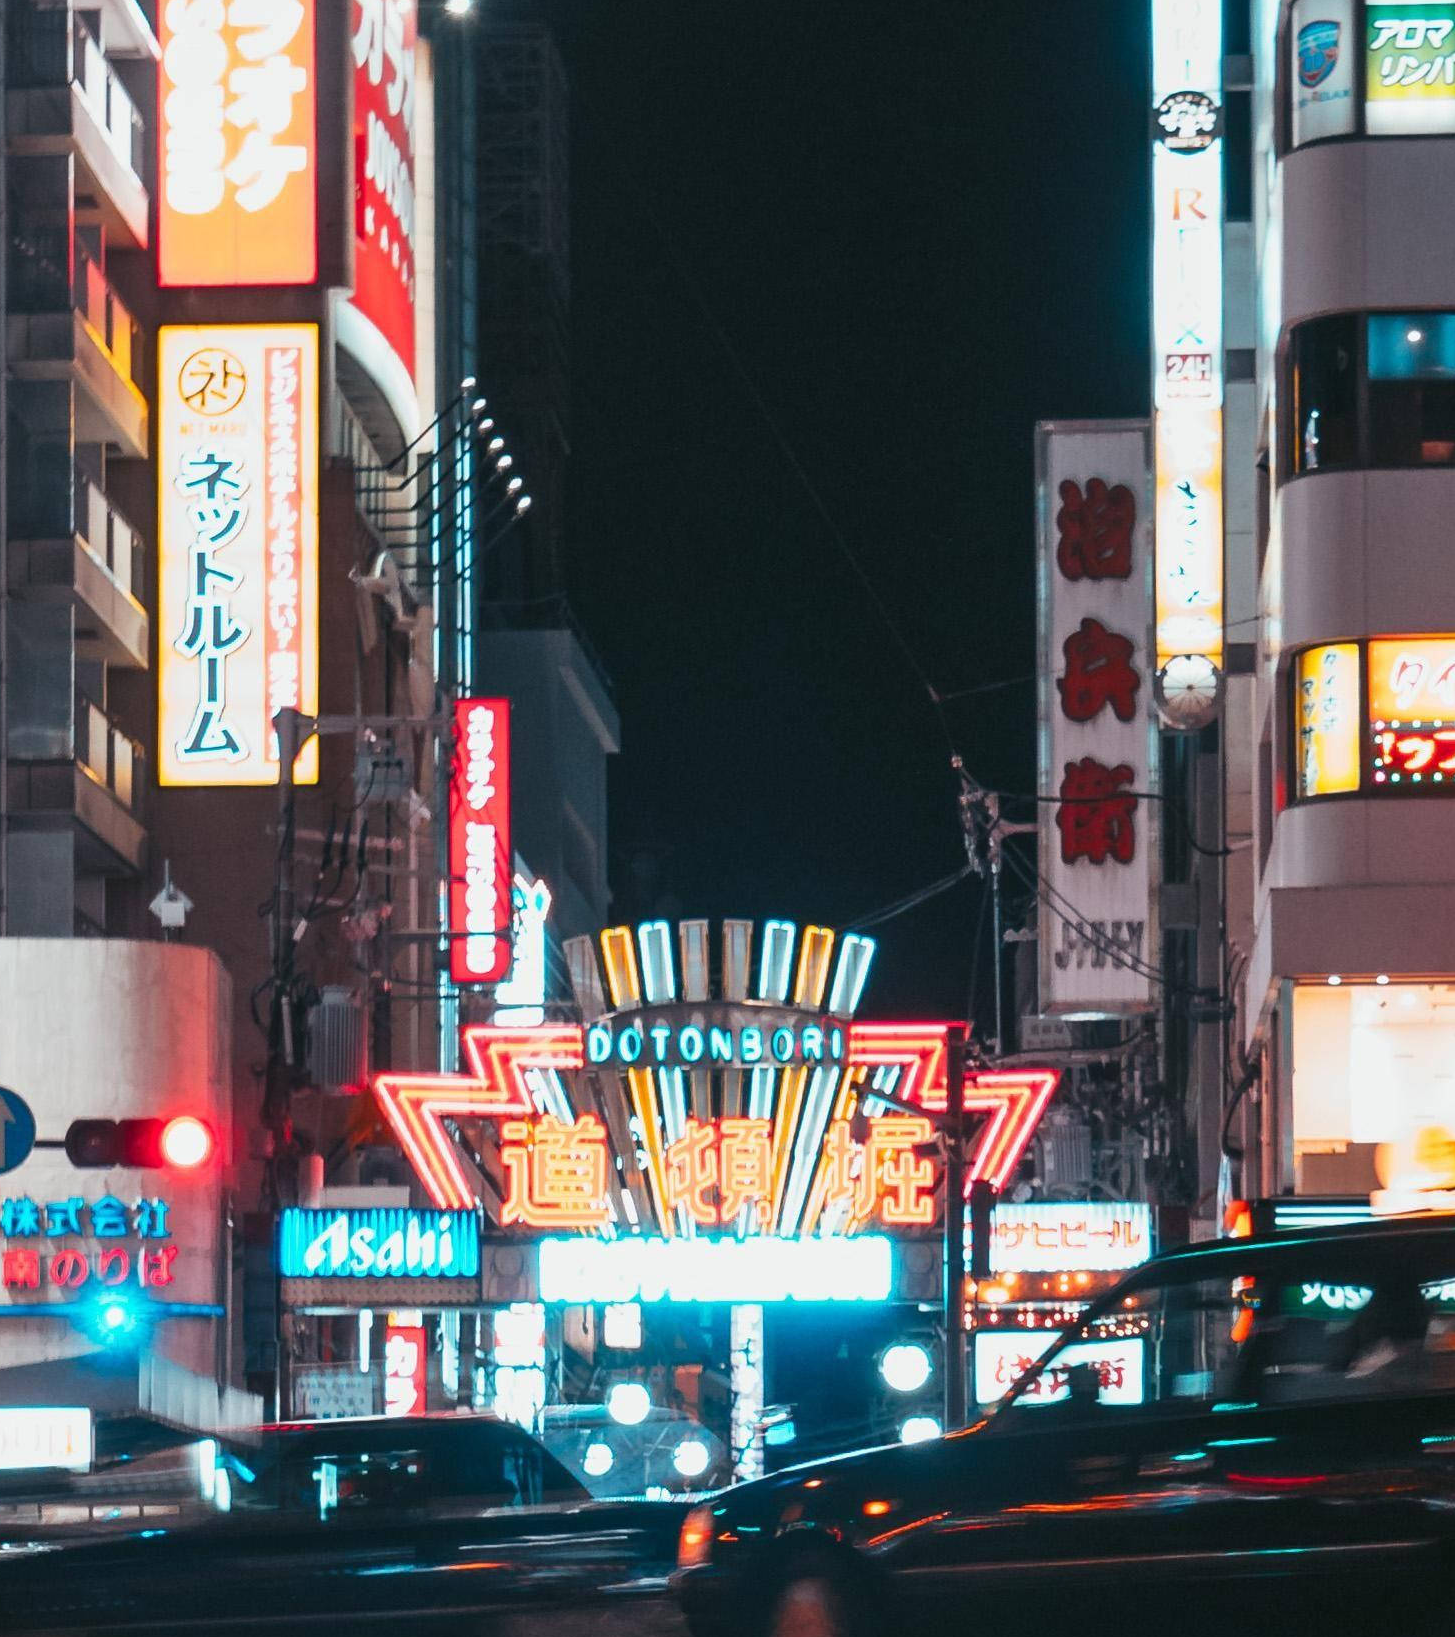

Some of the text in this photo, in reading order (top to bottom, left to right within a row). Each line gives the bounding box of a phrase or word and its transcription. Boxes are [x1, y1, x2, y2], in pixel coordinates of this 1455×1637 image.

[1369, 18, 1455, 50] アロマ
[181, 451, 244, 757] ネットルーム
[586, 1024, 844, 1064] DOTONBORI
[499, 1113, 936, 1229] 道頓堀
[302, 1213, 455, 1271] Asahi
